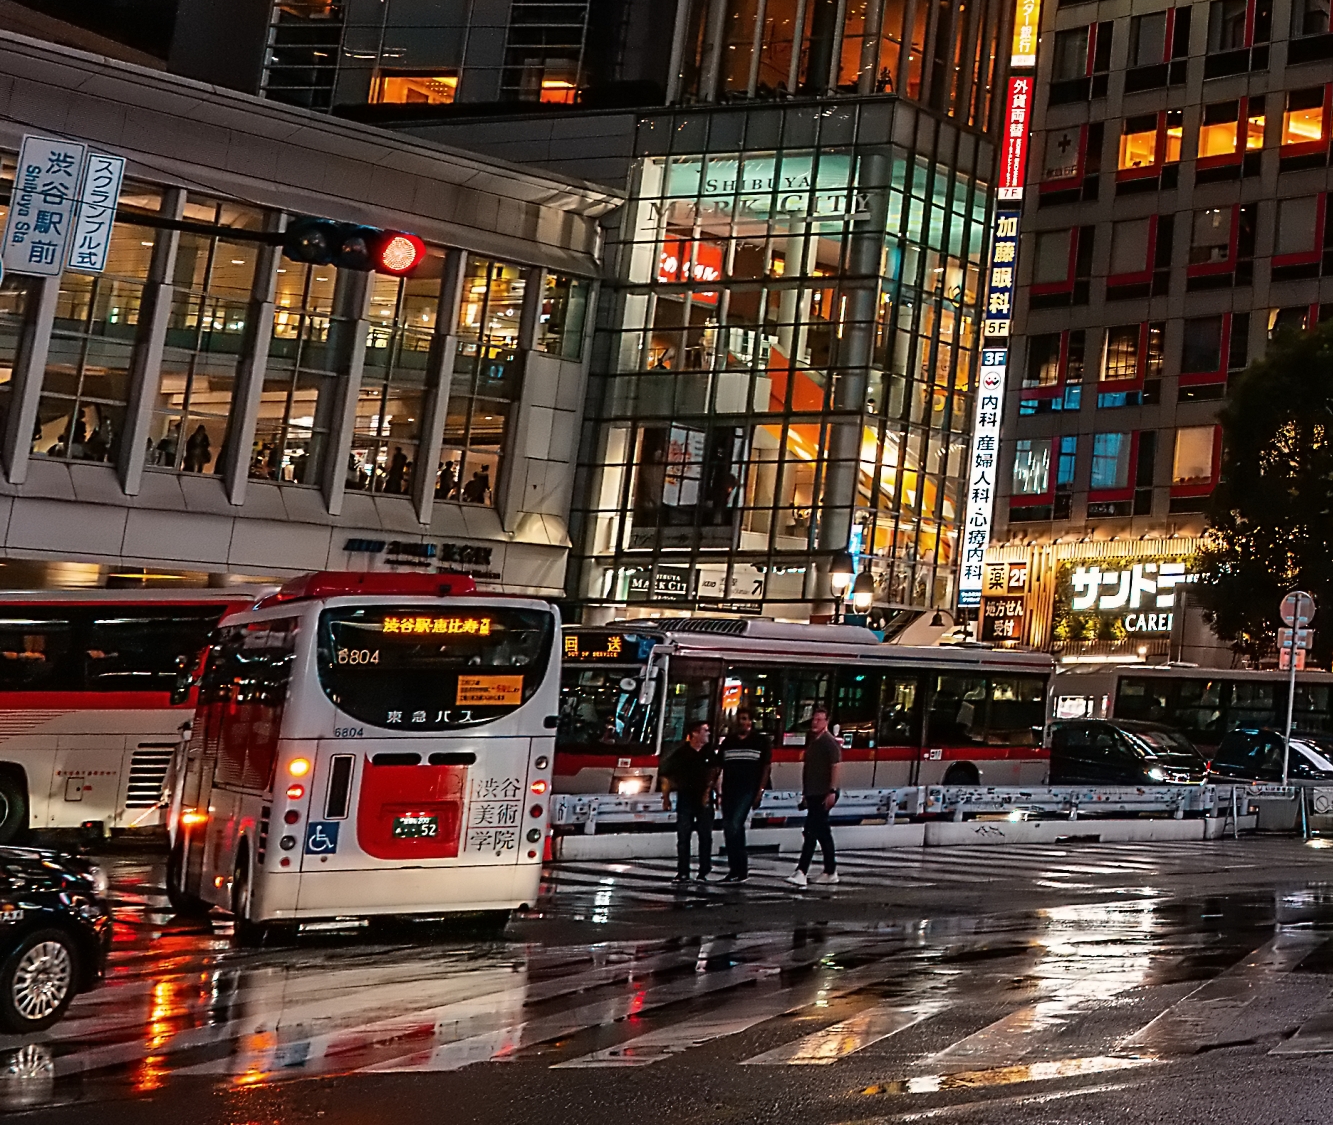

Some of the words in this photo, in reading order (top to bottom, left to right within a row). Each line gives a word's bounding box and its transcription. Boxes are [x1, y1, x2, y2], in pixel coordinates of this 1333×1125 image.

[1010, 78, 1029, 138] 外貨両替
[20, 164, 42, 220] Shibuya
[706, 176, 812, 194] SHIBUYA
[1004, 188, 1018, 197] 7F
[28, 150, 76, 265] 渋谷駅前
[76, 159, 114, 267] スクランブル式
[778, 192, 877, 217] CITY
[12, 212, 31, 248] Sta.
[989, 216, 1017, 314] 加藤眼科
[988, 321, 1007, 334] 5F
[985, 351, 1005, 366] 3F
[978, 394, 999, 427] 内科
[988, 567, 1005, 590] 薬
[1009, 568, 1027, 587] 2F
[1072, 563, 1200, 611] サンドラ
[985, 600, 1023, 616] 処方せん
[993, 620, 1014, 637] 受付
[565, 636, 622, 652] 回送
[336, 649, 380, 665] 6804
[387, 709, 474, 724] 東急バス
[334, 727, 365, 738] 6804
[475, 777, 522, 799] 渋谷
[473, 804, 519, 826] 美術
[470, 830, 516, 852] 学院
